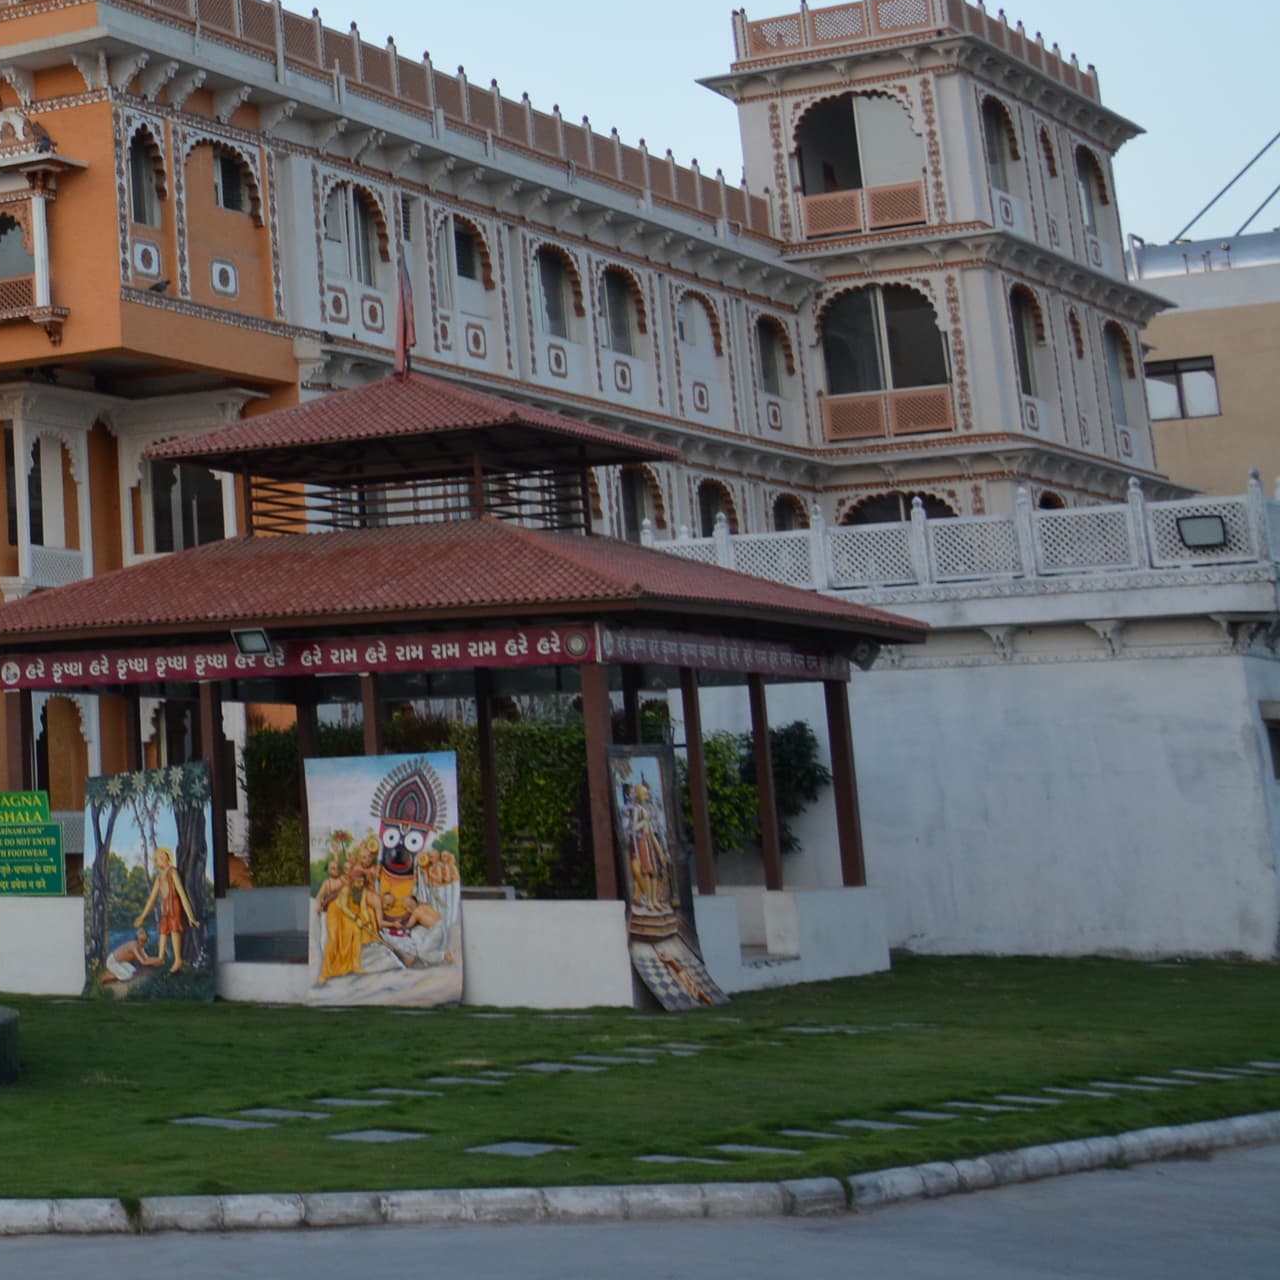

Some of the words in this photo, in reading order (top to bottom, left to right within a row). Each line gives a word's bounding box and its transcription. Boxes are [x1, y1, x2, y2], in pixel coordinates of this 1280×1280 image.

[25, 658, 46, 680] હરે
[51, 661, 83, 684] કૃષ્ણ
[89, 654, 110, 677] હરે
[116, 656, 148, 680] કૃષ્ણ
[154, 655, 187, 679] કૃષ્ણ
[193, 653, 227, 677] કૃષ્ણ
[234, 652, 257, 669] હર
[300, 644, 322, 667] હરે
[330, 647, 358, 664] રામ
[365, 642, 387, 664] હરે
[395, 645, 423, 662] રામ
[431, 642, 459, 659] રામ
[467, 639, 496, 657] રામ
[505, 632, 528, 657] હરે
[537, 630, 561, 654] હરે
[4, 838, 15, 846] DO
[16, 837, 31, 846] NOT
[32, 837, 56, 846] ENTER
[7, 848, 48, 858] FOOTWEAR
